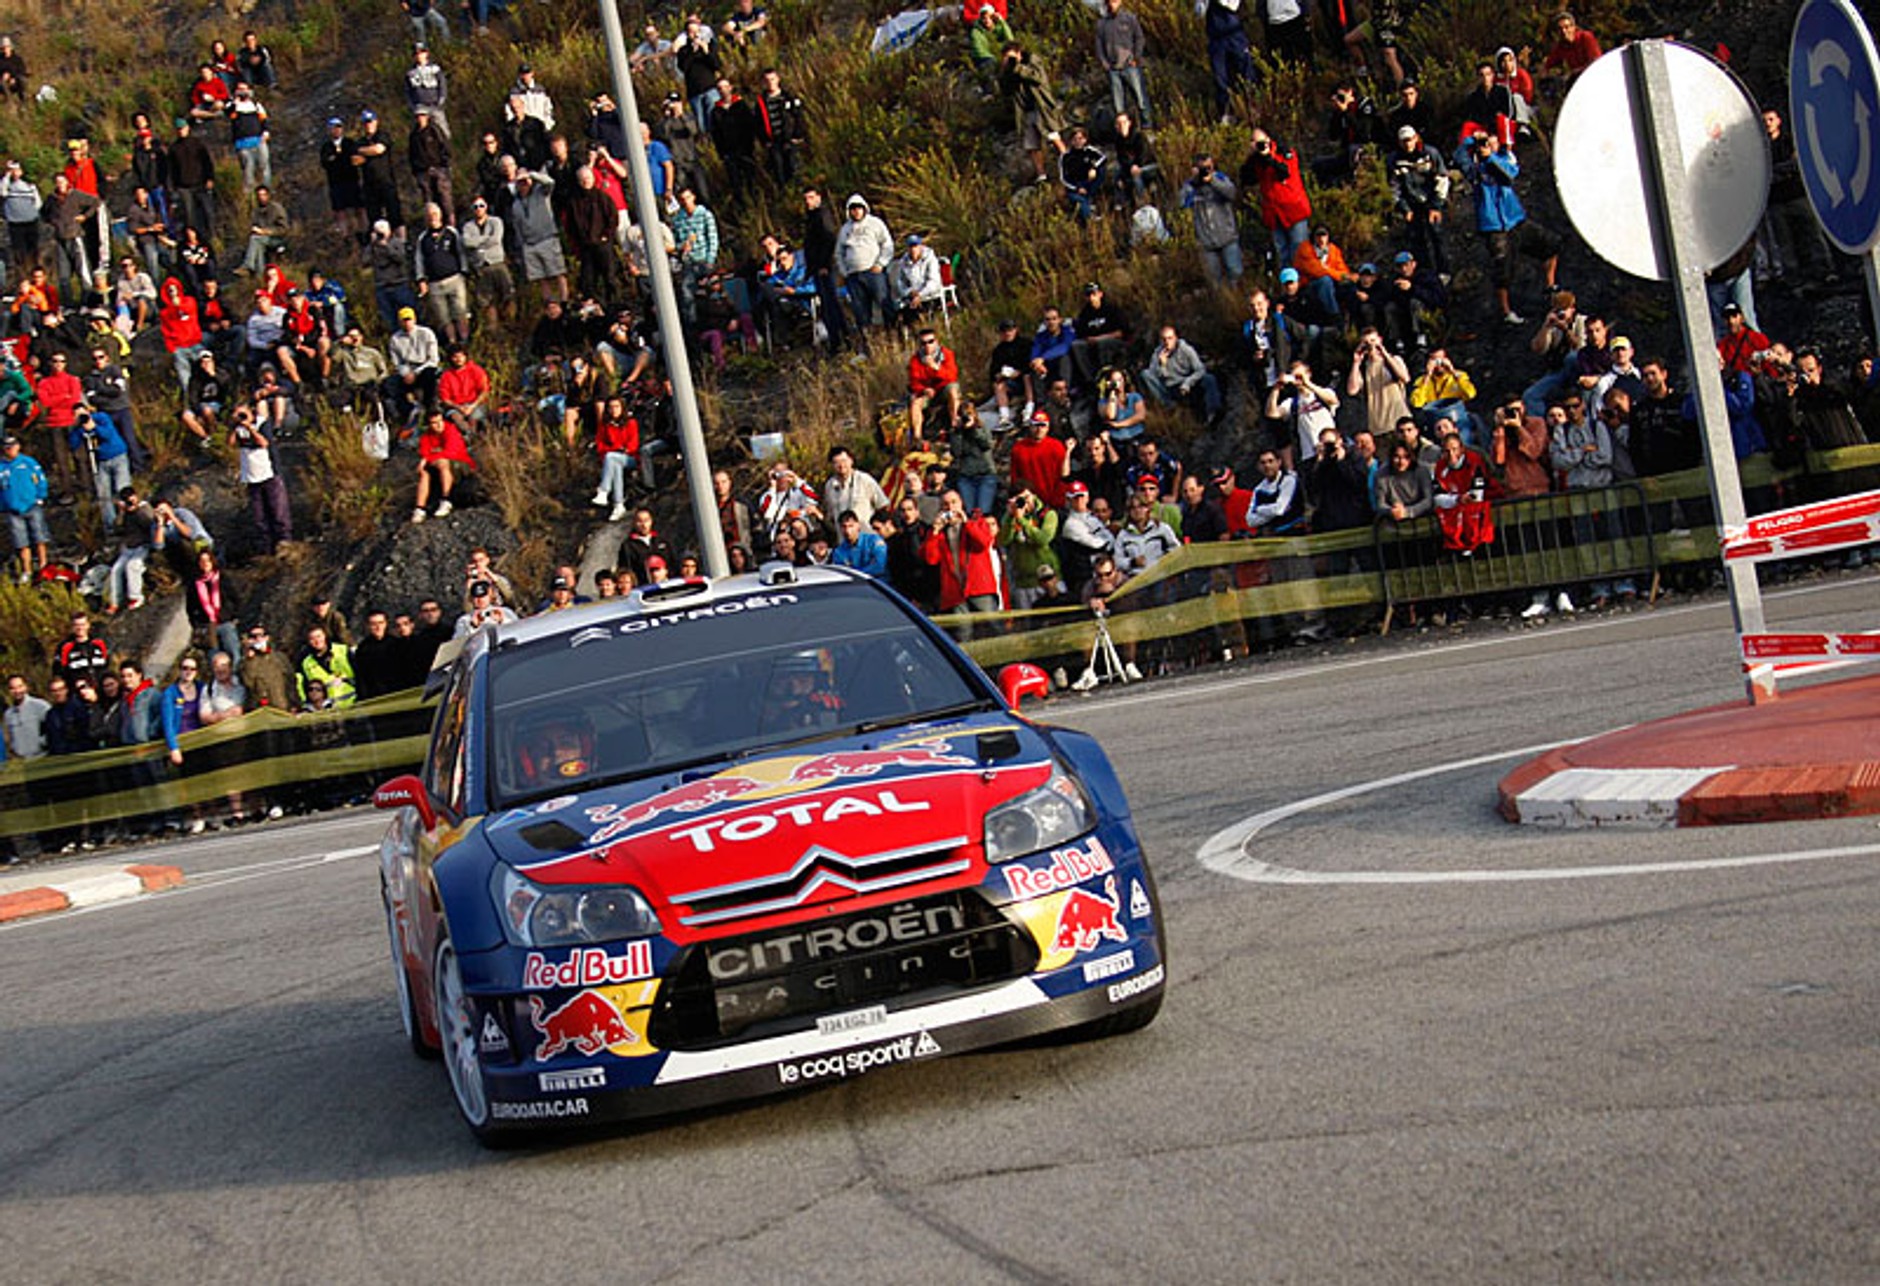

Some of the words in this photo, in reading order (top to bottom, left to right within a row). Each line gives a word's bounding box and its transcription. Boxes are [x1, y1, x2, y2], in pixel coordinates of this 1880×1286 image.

[1757, 514, 1804, 530] PELIGRO
[377, 790, 411, 802] TOTAL
[669, 791, 930, 852] TOTAL
[1003, 852, 1074, 898] Red
[1066, 836, 1115, 881] Bull
[524, 950, 580, 988] Red
[583, 940, 653, 985] Bull
[778, 1062, 799, 1083] le
[801, 1055, 846, 1077] coq
[846, 1037, 913, 1073] sportif
[539, 1067, 607, 1092] PIRELLI
[491, 1098, 589, 1119] EURODATACAR
